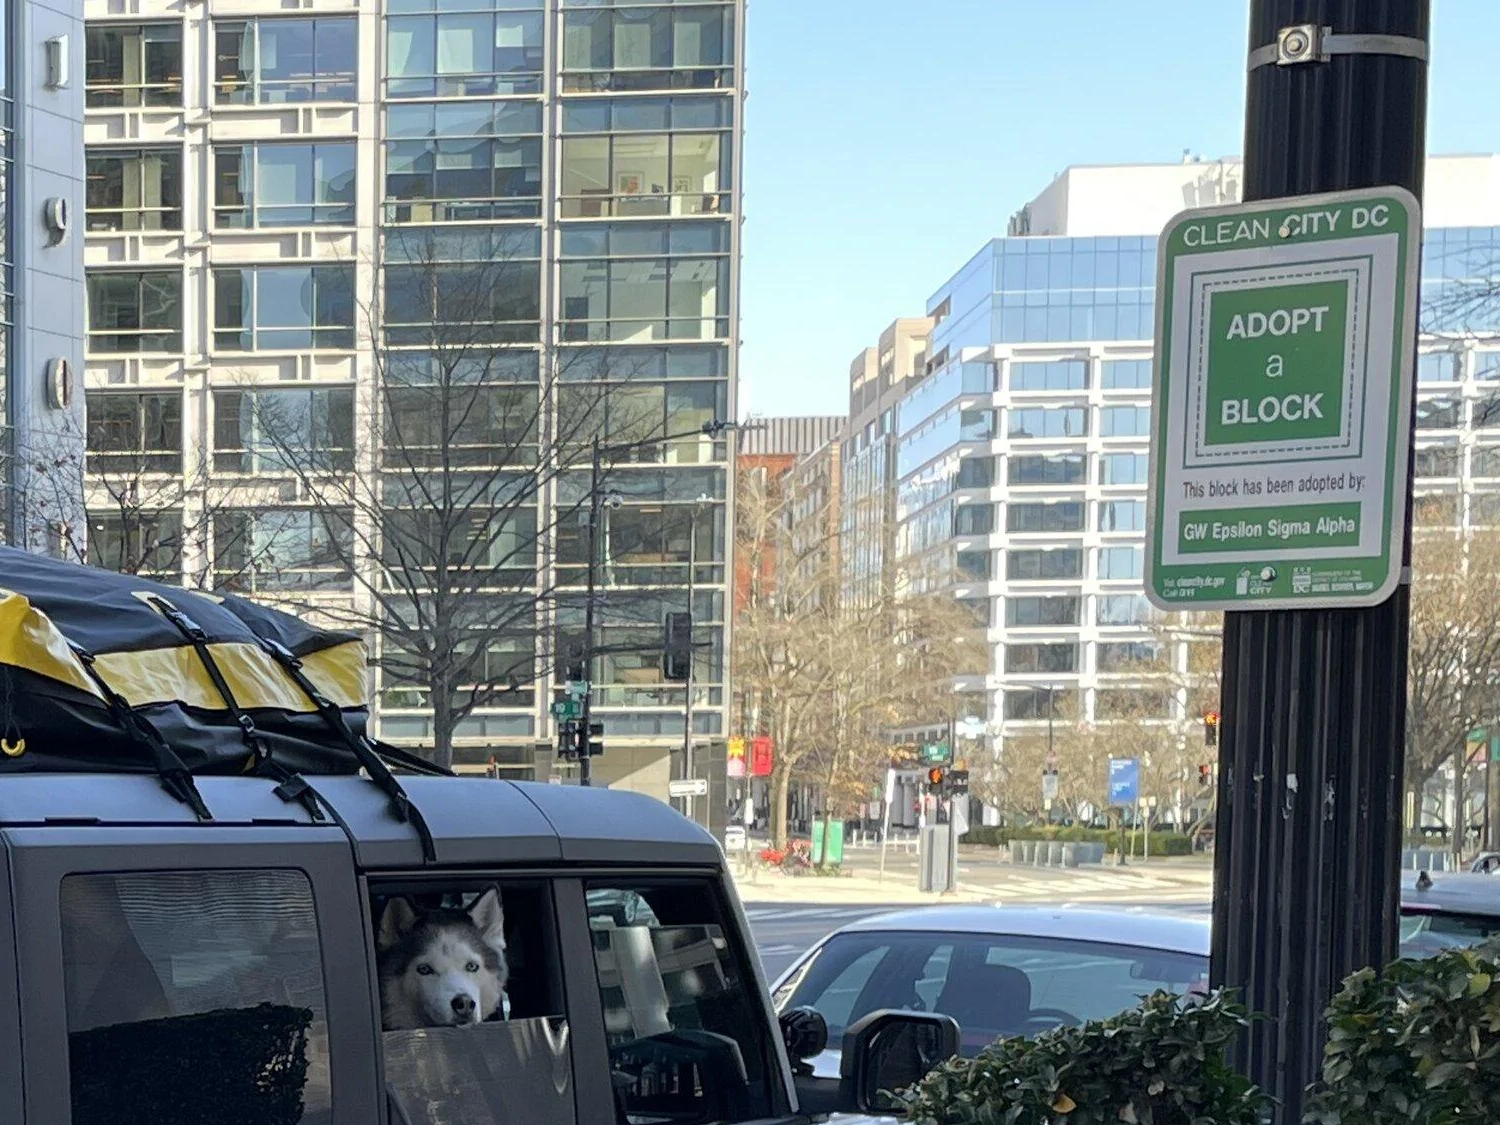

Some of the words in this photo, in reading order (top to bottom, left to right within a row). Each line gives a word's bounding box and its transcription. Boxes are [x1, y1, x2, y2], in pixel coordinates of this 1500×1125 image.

[1183, 217, 1270, 247] CLEAN
[1281, 209, 1342, 236] CITY
[1351, 204, 1390, 229] DC
[1226, 306, 1329, 340] ADOPT
[1265, 354, 1284, 377] a
[1221, 393, 1324, 425] BLOCK
[1182, 481, 1205, 498] This
[1208, 479, 1238, 497] block
[1242, 478, 1262, 495] has
[1266, 476, 1294, 494] been
[1298, 473, 1344, 494] adopted
[1184, 522, 1207, 540] GW
[1212, 519, 1262, 541] Epsilon
[1267, 518, 1311, 540] Sigma
[1316, 515, 1356, 537] Alpha
